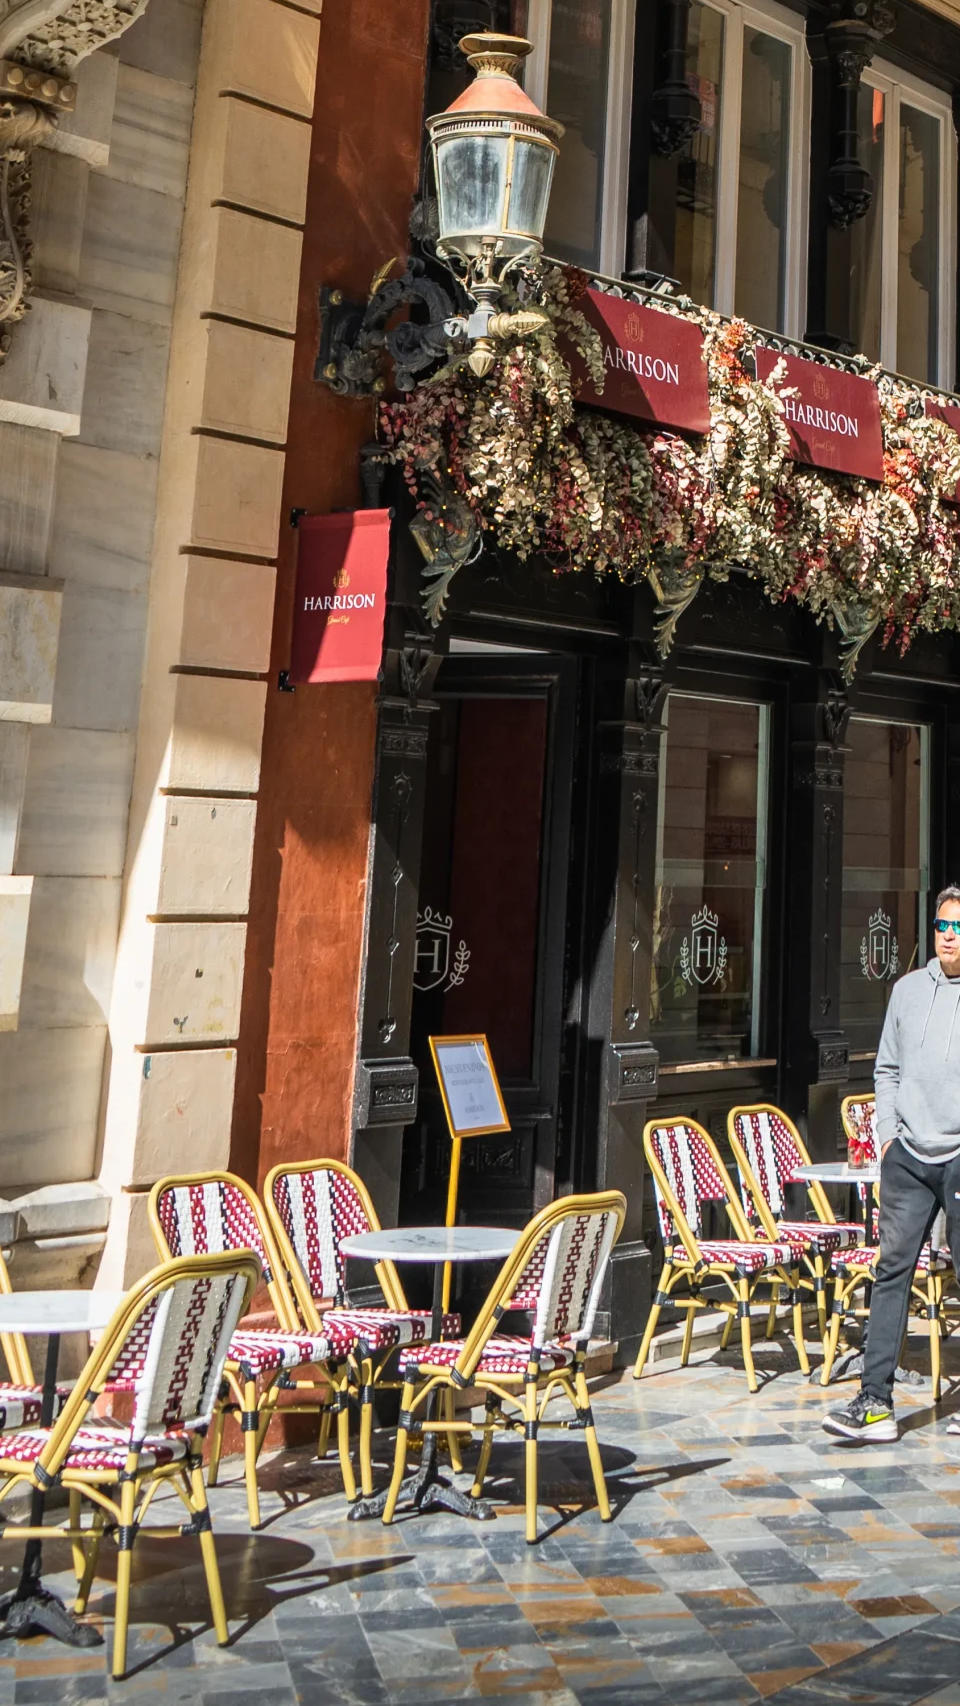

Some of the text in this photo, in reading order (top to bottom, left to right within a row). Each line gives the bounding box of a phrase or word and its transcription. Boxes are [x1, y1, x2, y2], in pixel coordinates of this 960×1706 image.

[604, 345, 679, 385] ARRISON
[784, 398, 859, 438] HARRISON
[304, 593, 375, 610] HARRISON
[413, 939, 442, 974] H
[695, 935, 713, 968] H
[872, 935, 887, 965] H
